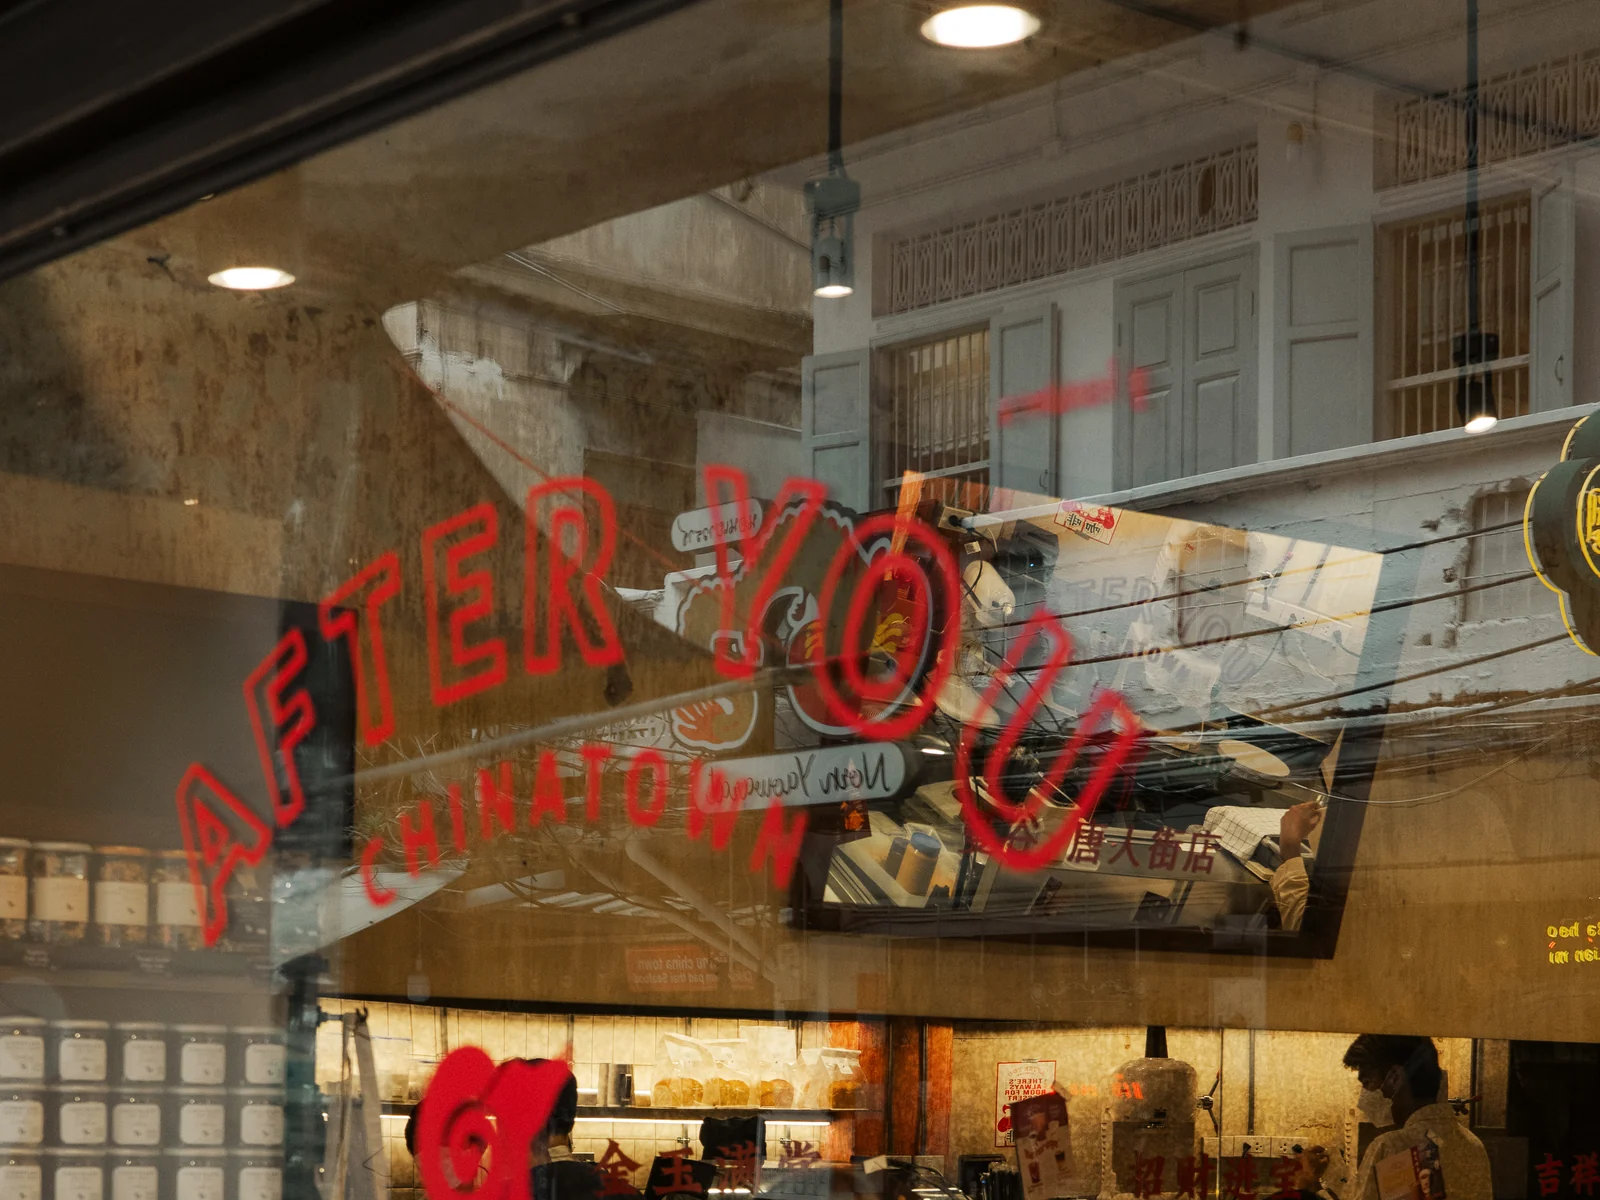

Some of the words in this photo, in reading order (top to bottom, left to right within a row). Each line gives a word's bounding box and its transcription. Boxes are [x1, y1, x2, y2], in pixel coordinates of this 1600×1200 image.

[175, 477, 626, 948] AFTER
[704, 464, 1145, 872] YOU
[361, 744, 806, 907] CHINATOWN
